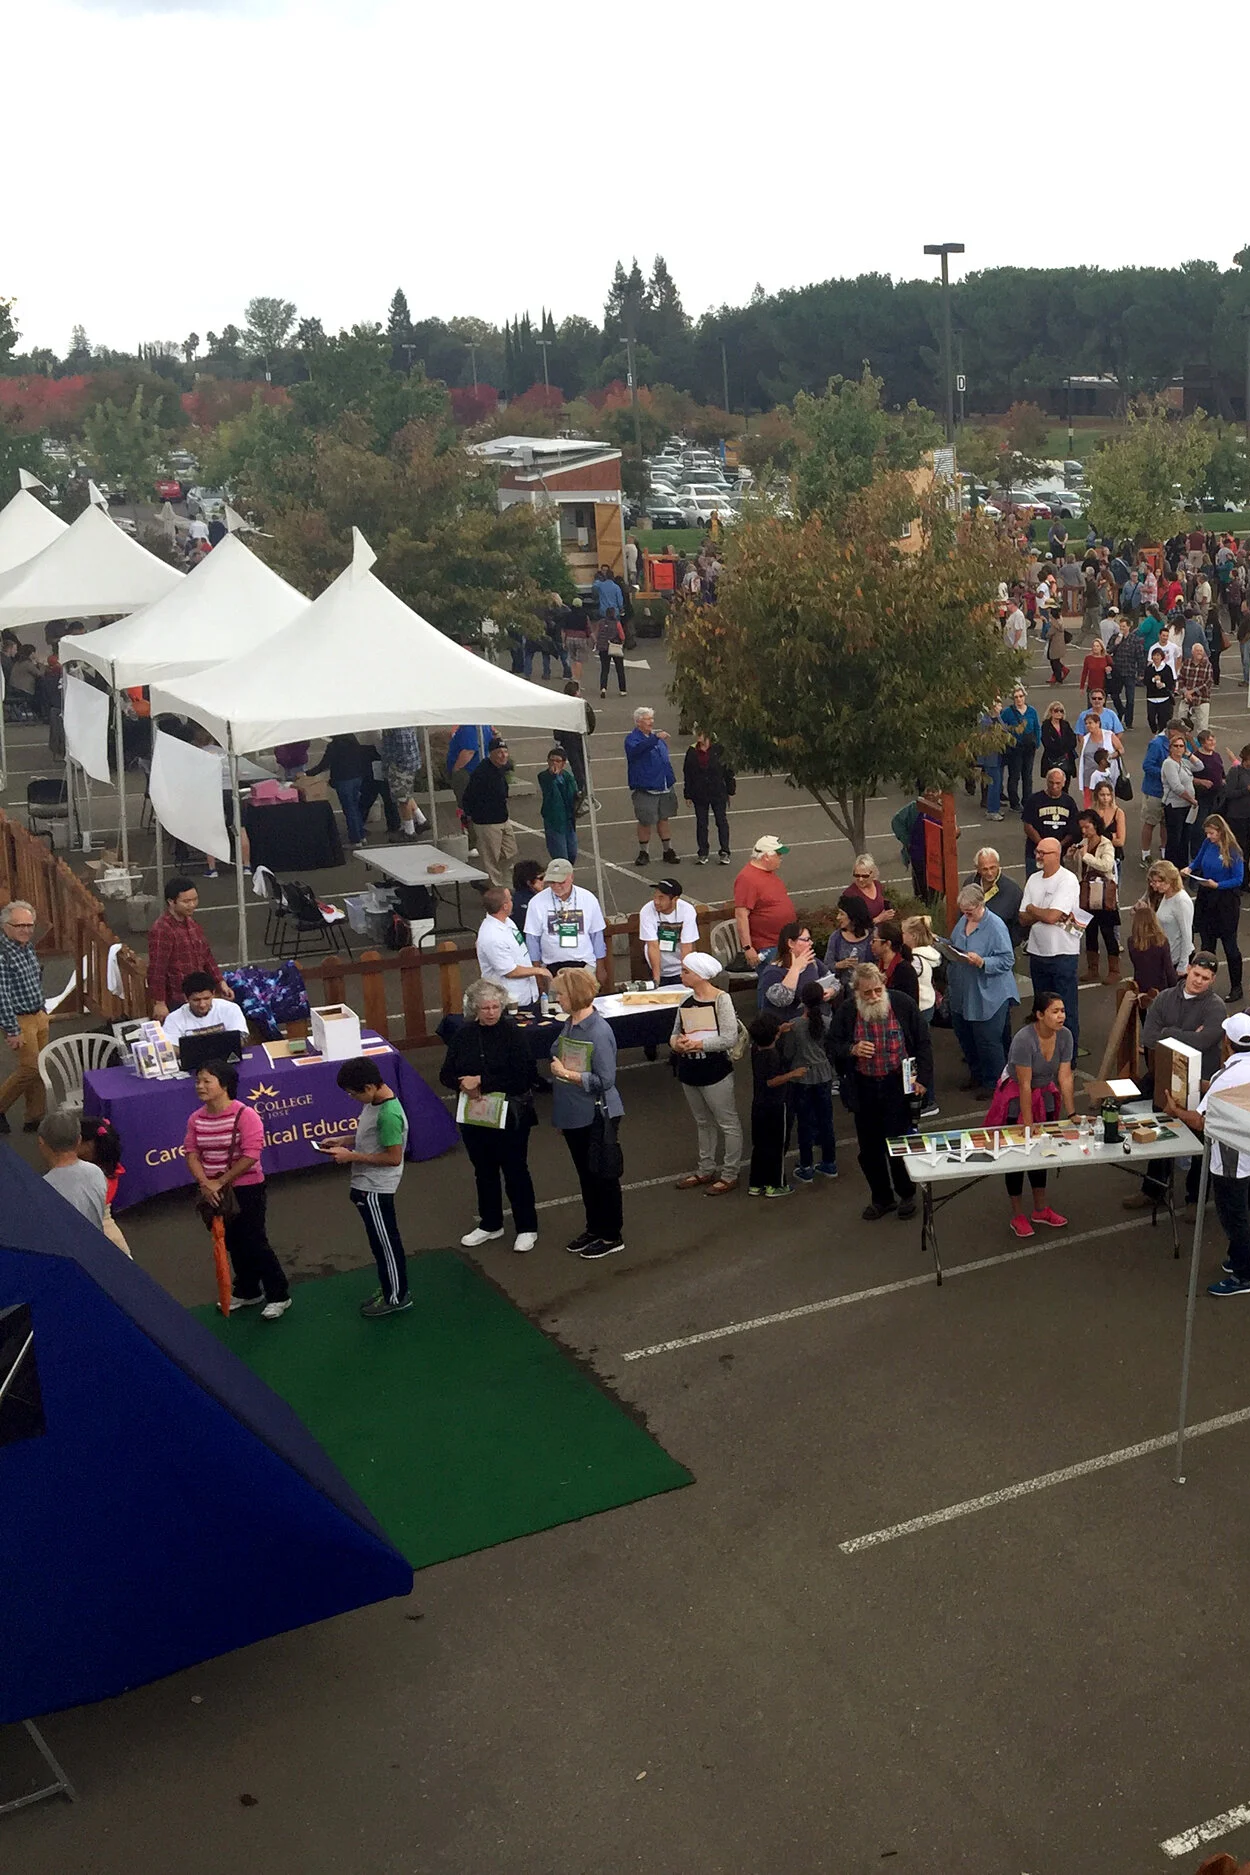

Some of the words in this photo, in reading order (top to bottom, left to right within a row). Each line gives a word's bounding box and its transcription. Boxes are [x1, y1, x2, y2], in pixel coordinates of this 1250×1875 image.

[959, 377, 965, 389] D
[254, 1094, 313, 1113] COLLEGE
[302, 1118, 360, 1139] Educa
